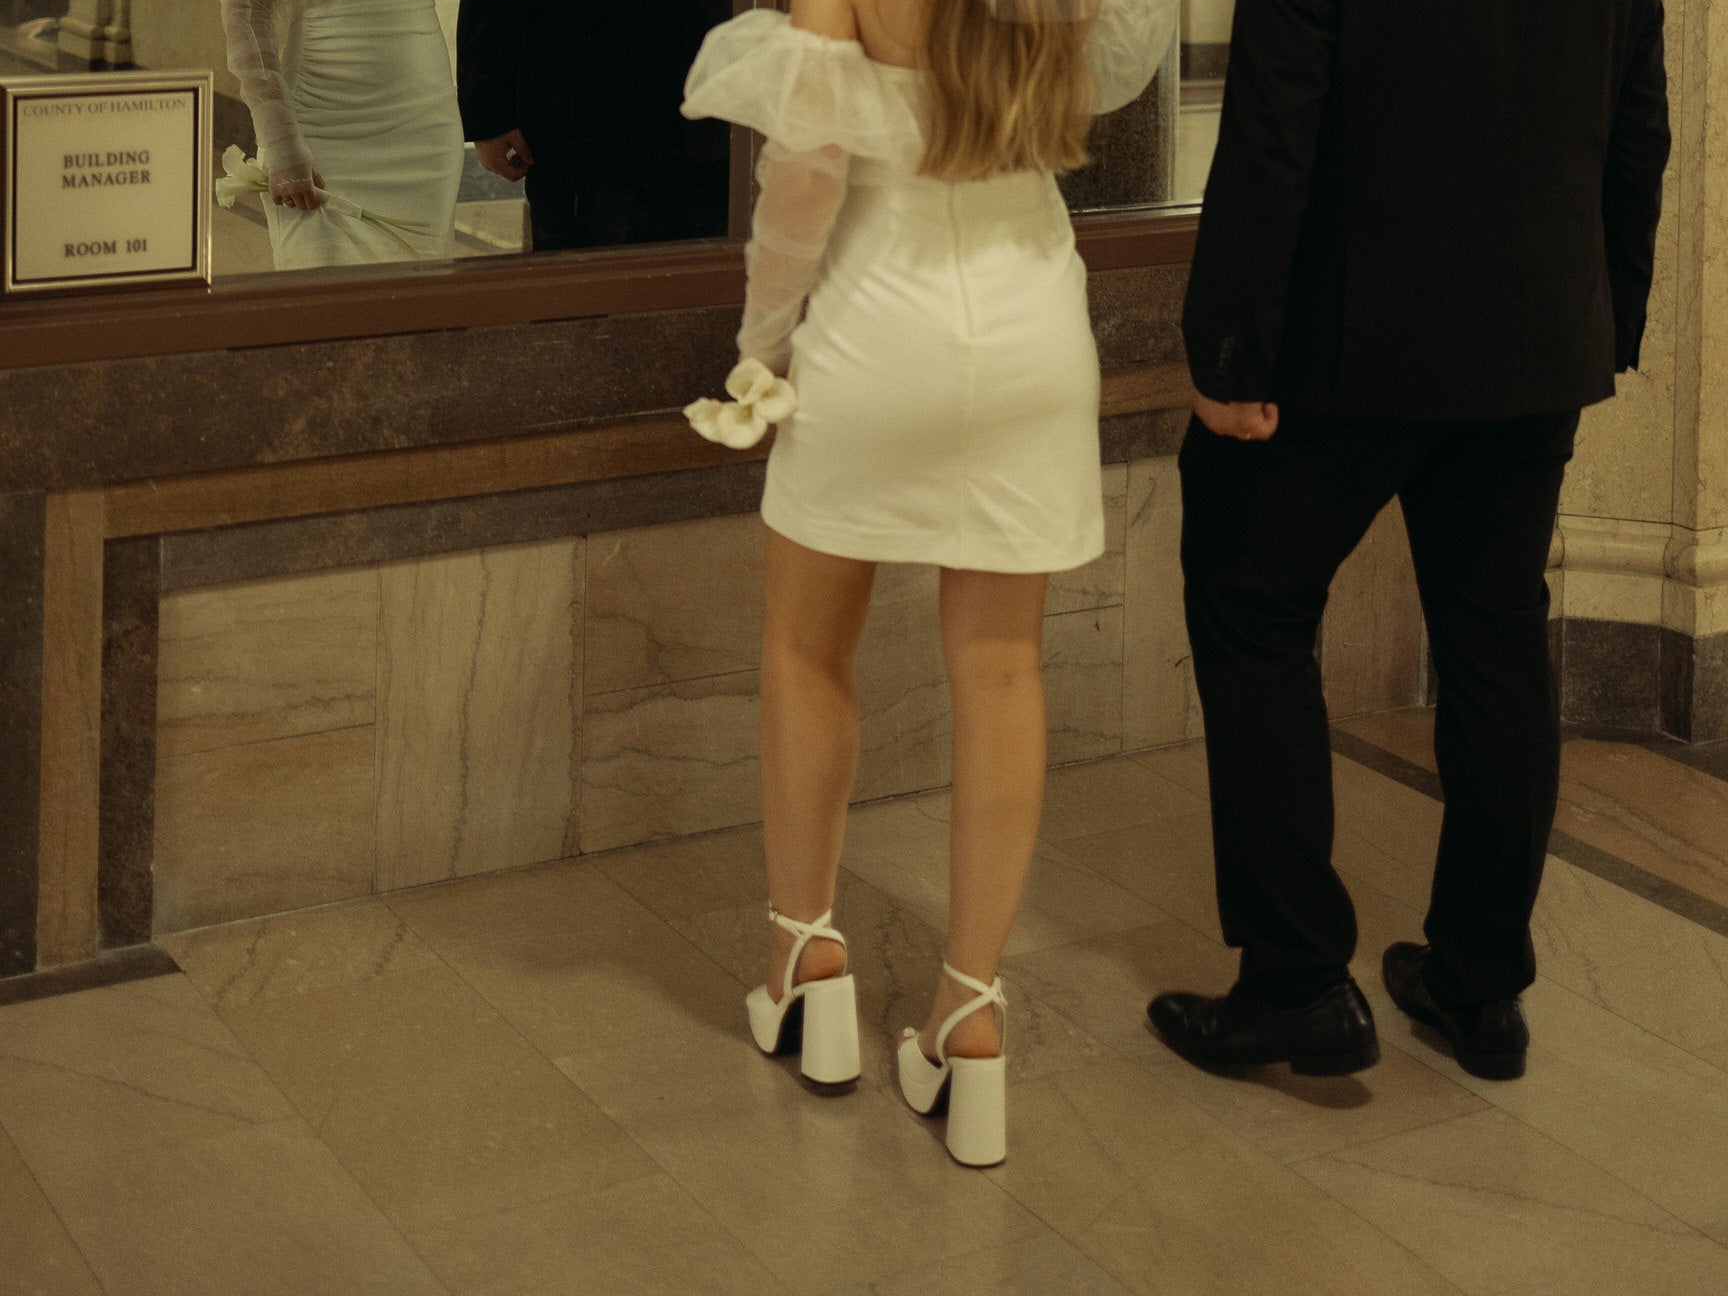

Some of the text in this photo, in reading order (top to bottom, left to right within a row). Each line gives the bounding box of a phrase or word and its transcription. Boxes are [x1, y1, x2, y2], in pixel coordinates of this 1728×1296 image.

[23, 99, 186, 117] COUNTY OF HAMILTON
[63, 150, 150, 169] BUILDING
[62, 170, 152, 189] MANAGER
[64, 238, 148, 257] ROOM 101
